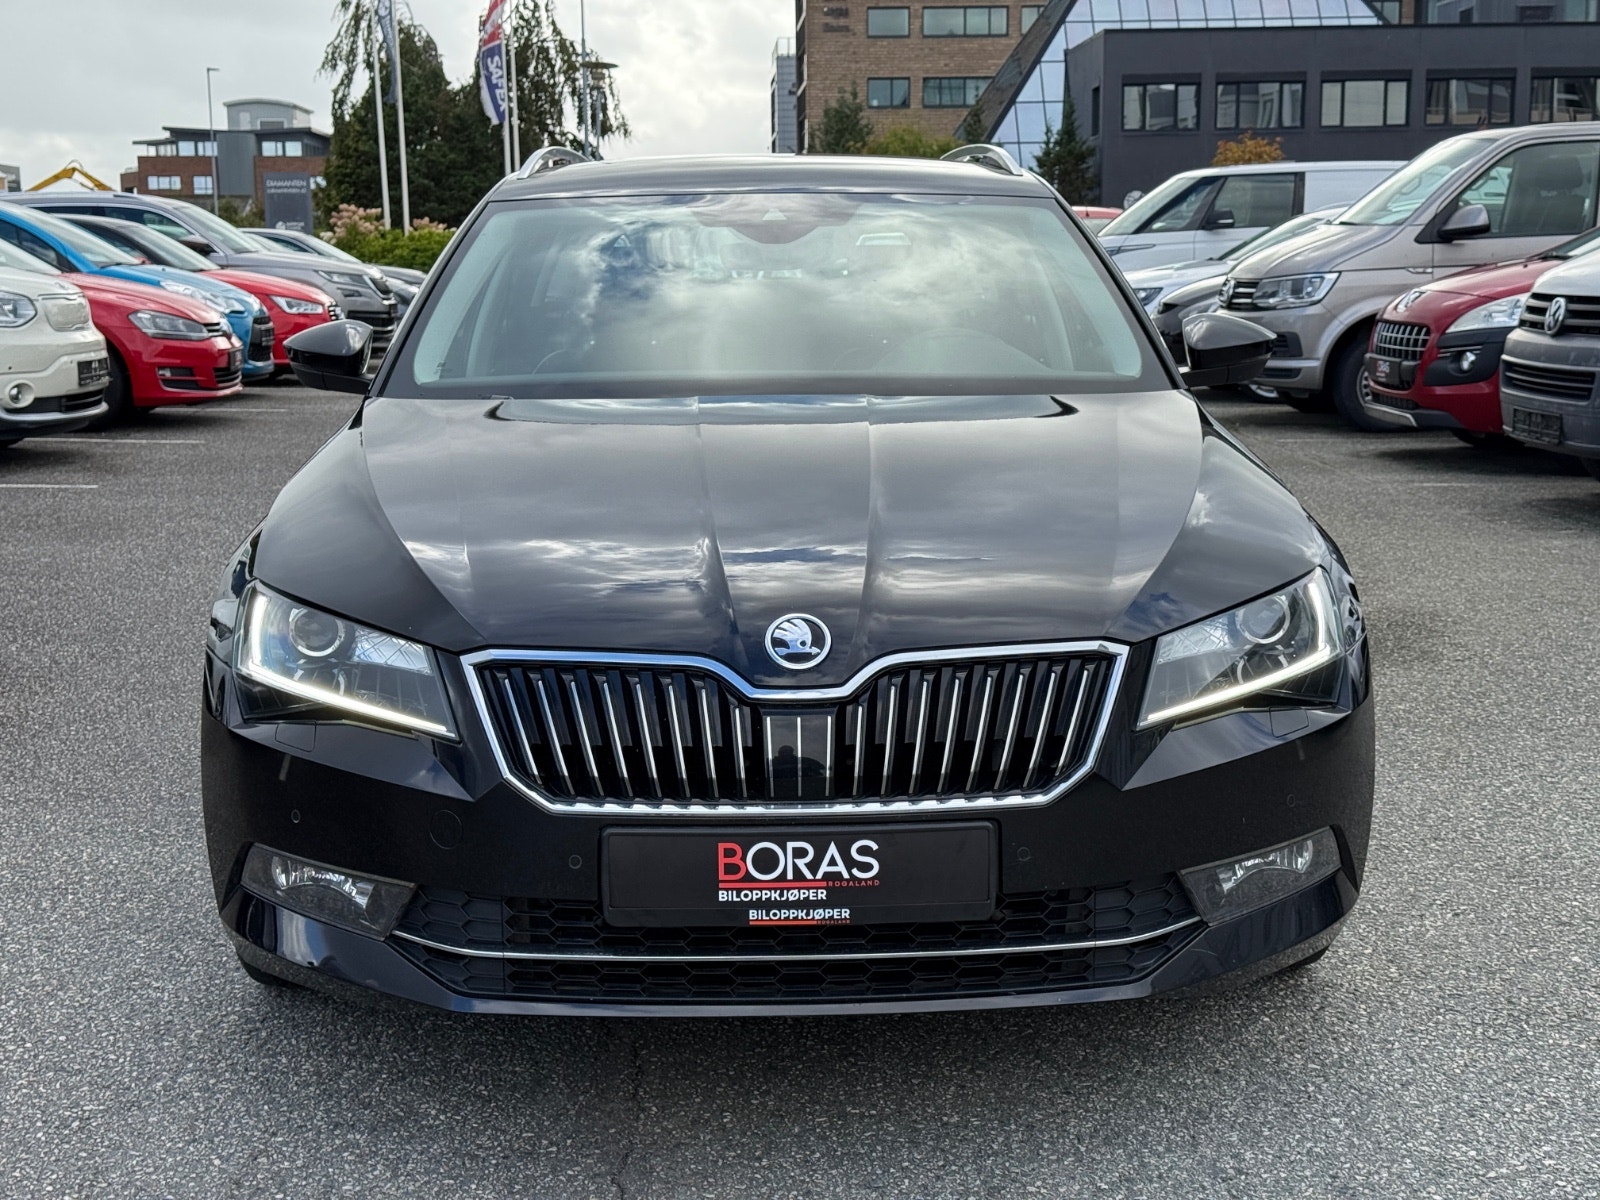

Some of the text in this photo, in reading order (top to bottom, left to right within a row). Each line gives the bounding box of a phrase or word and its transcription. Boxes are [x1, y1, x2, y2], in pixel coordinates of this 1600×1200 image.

[718, 839, 880, 881] BORAS
[718, 889, 827, 902] BILOPPKJØPER
[749, 908, 850, 920] BILOPPKJØPER
